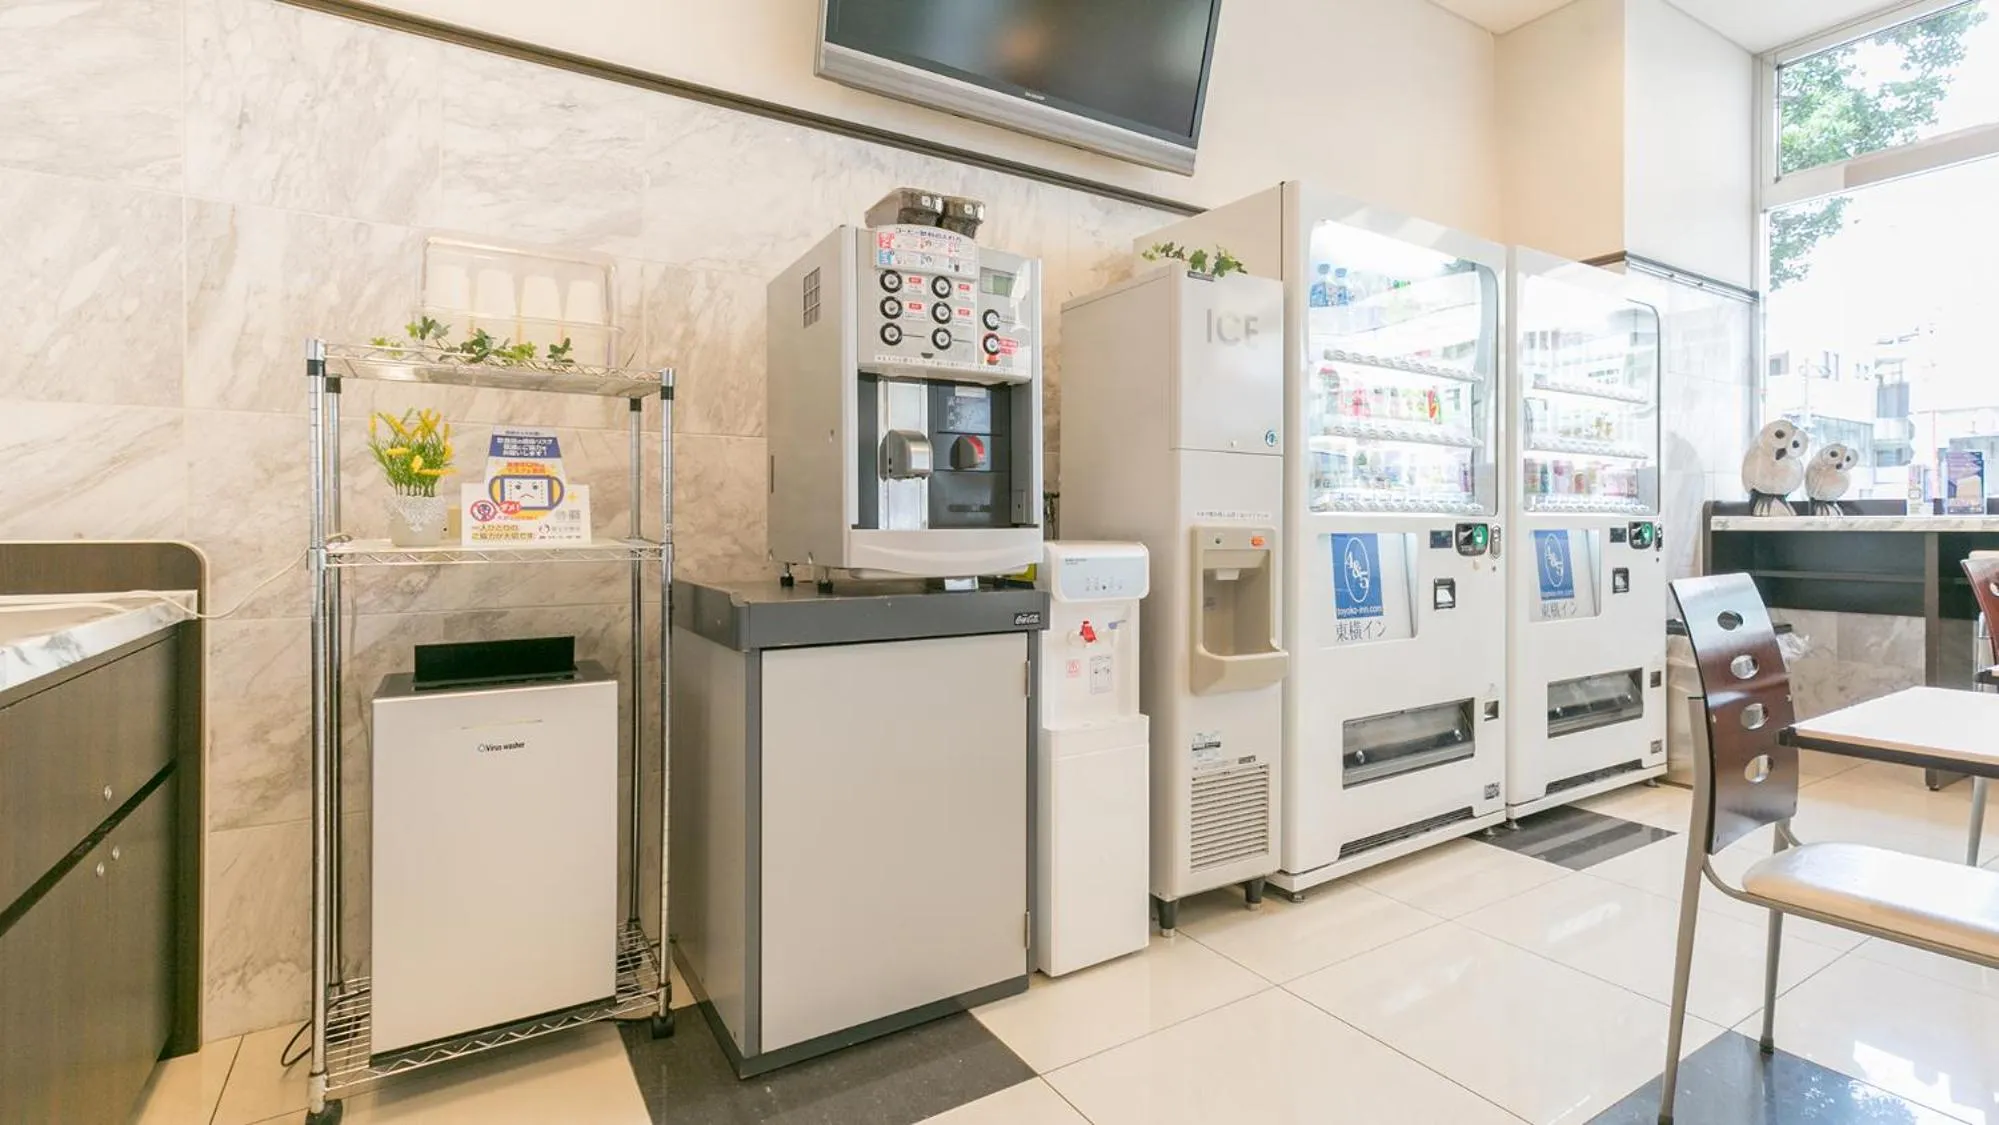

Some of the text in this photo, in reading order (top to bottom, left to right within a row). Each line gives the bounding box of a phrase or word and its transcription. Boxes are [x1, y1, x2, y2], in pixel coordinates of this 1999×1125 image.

[1335, 620, 1387, 642] 東横イン
[485, 741, 525, 752] Virus washer
